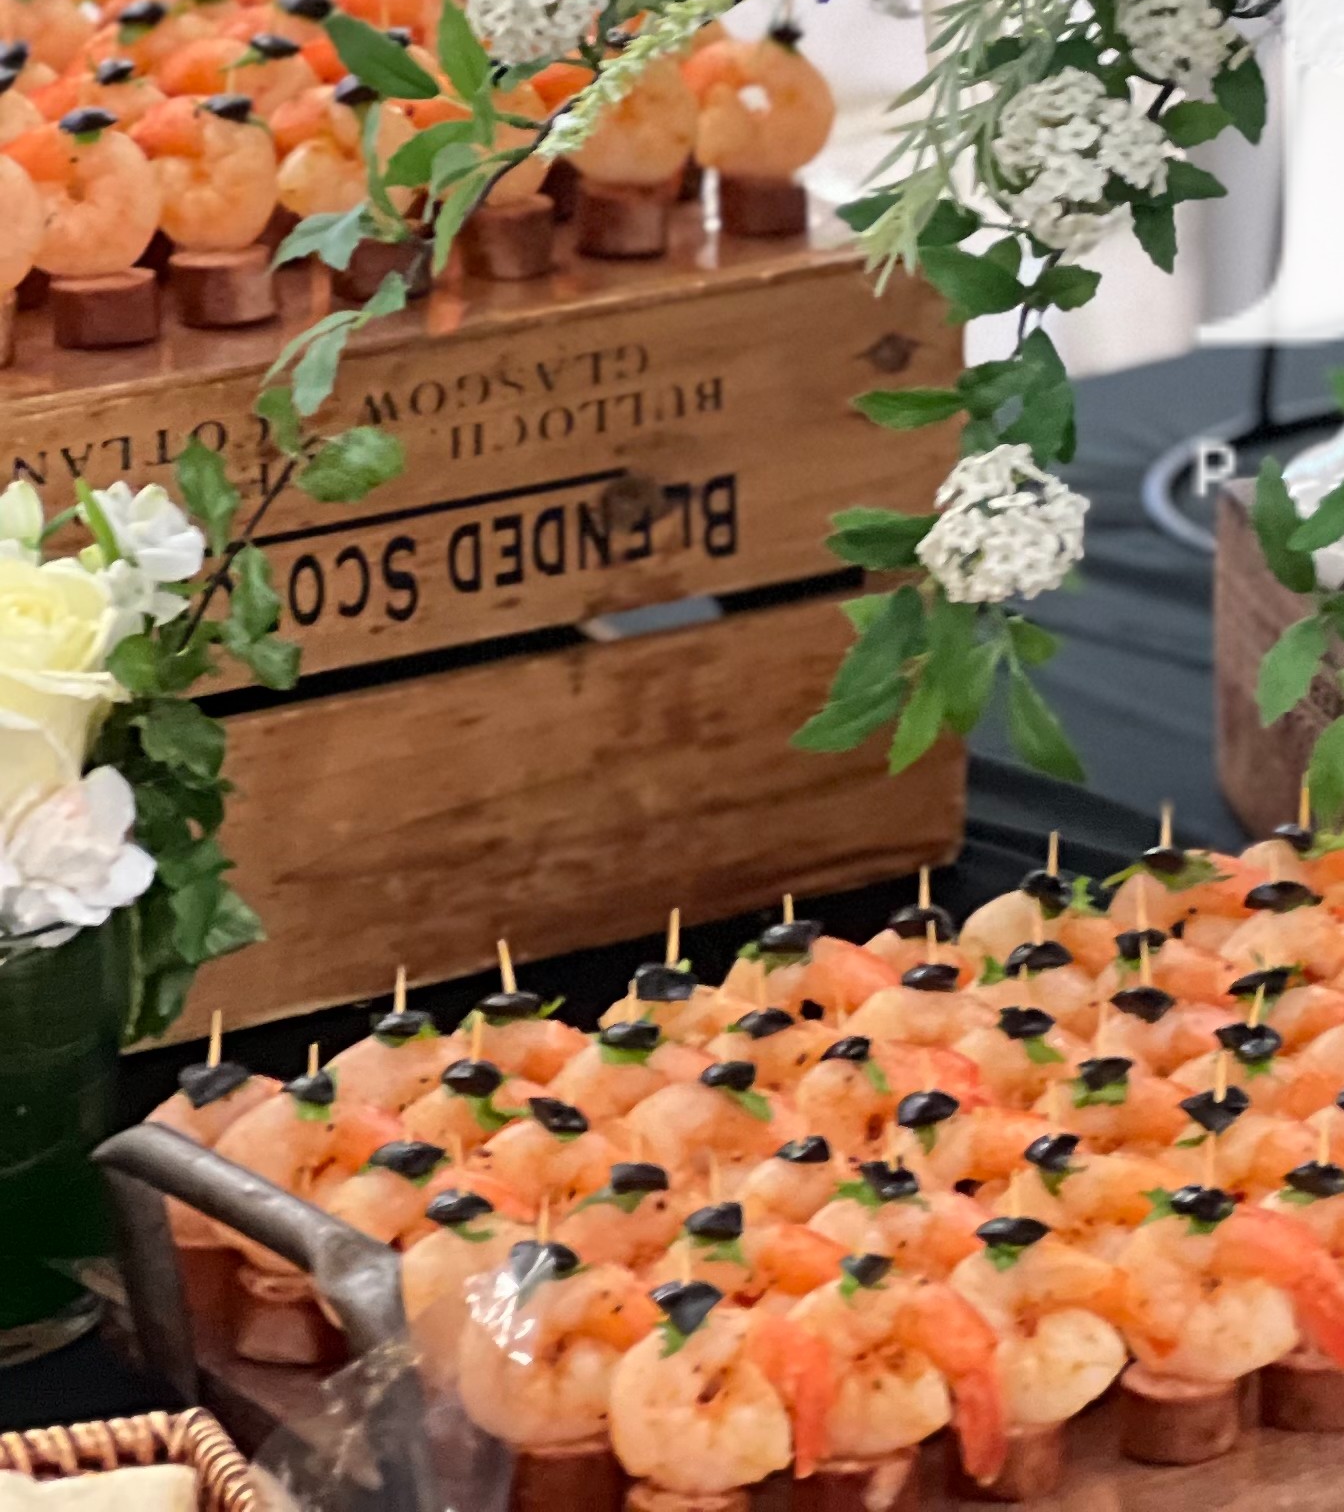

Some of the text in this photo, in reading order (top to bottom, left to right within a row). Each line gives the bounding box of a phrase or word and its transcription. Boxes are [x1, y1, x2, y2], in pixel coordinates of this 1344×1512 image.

[363, 344, 650, 425] GLASGOW
[12, 419, 287, 486] COTLAN
[447, 473, 738, 593] BLENDED
